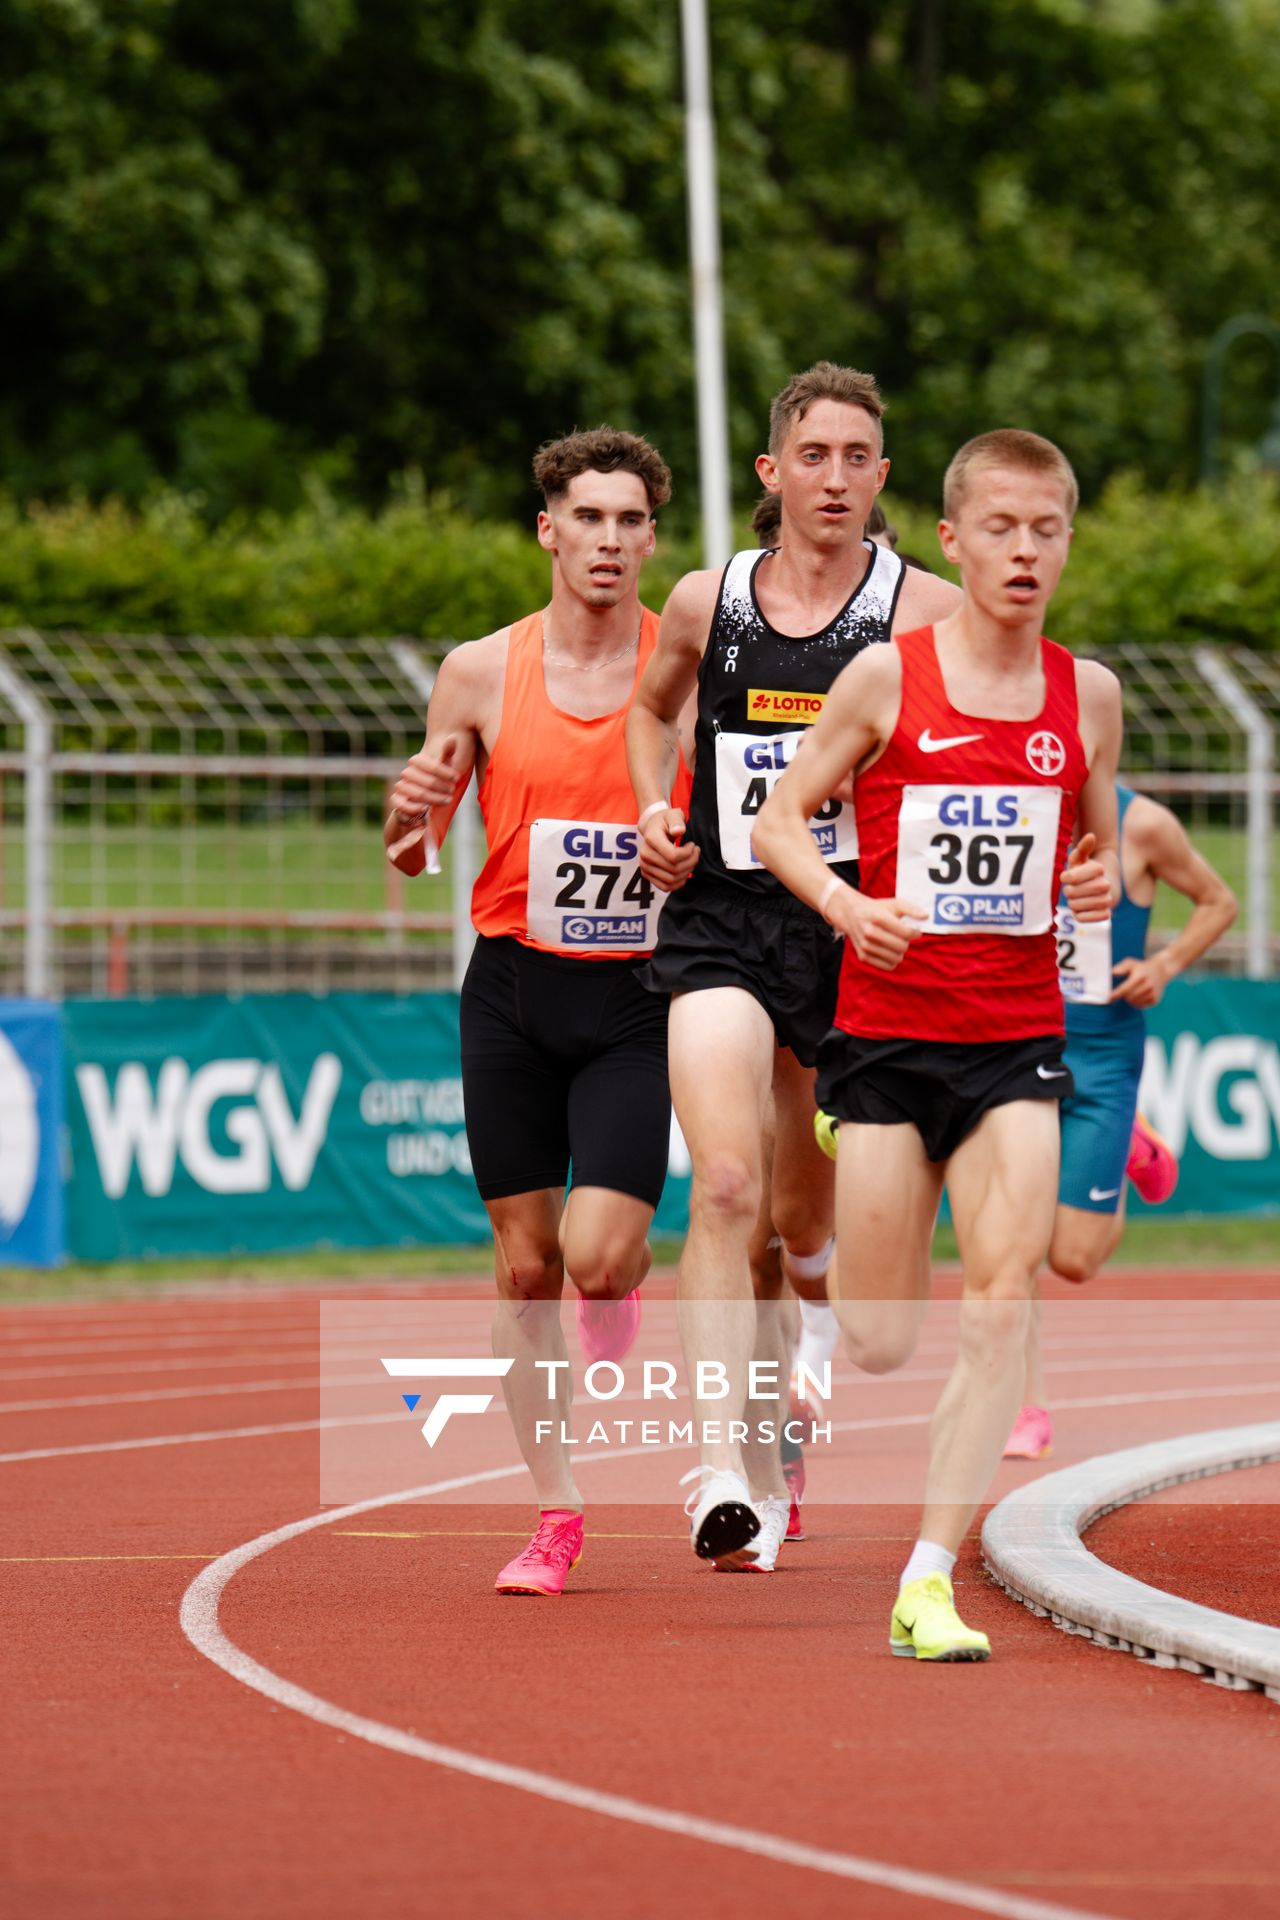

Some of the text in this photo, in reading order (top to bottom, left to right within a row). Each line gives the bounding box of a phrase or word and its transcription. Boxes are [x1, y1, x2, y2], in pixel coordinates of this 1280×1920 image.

[773, 697, 822, 712] LOTTO
[744, 741, 803, 770] GL
[563, 828, 638, 860] GLS
[928, 833, 1034, 886] 367
[555, 862, 655, 910] 274
[973, 899, 1021, 914] PLAN
[596, 921, 643, 933] PLAN
[75, 1053, 342, 1198] WGV
